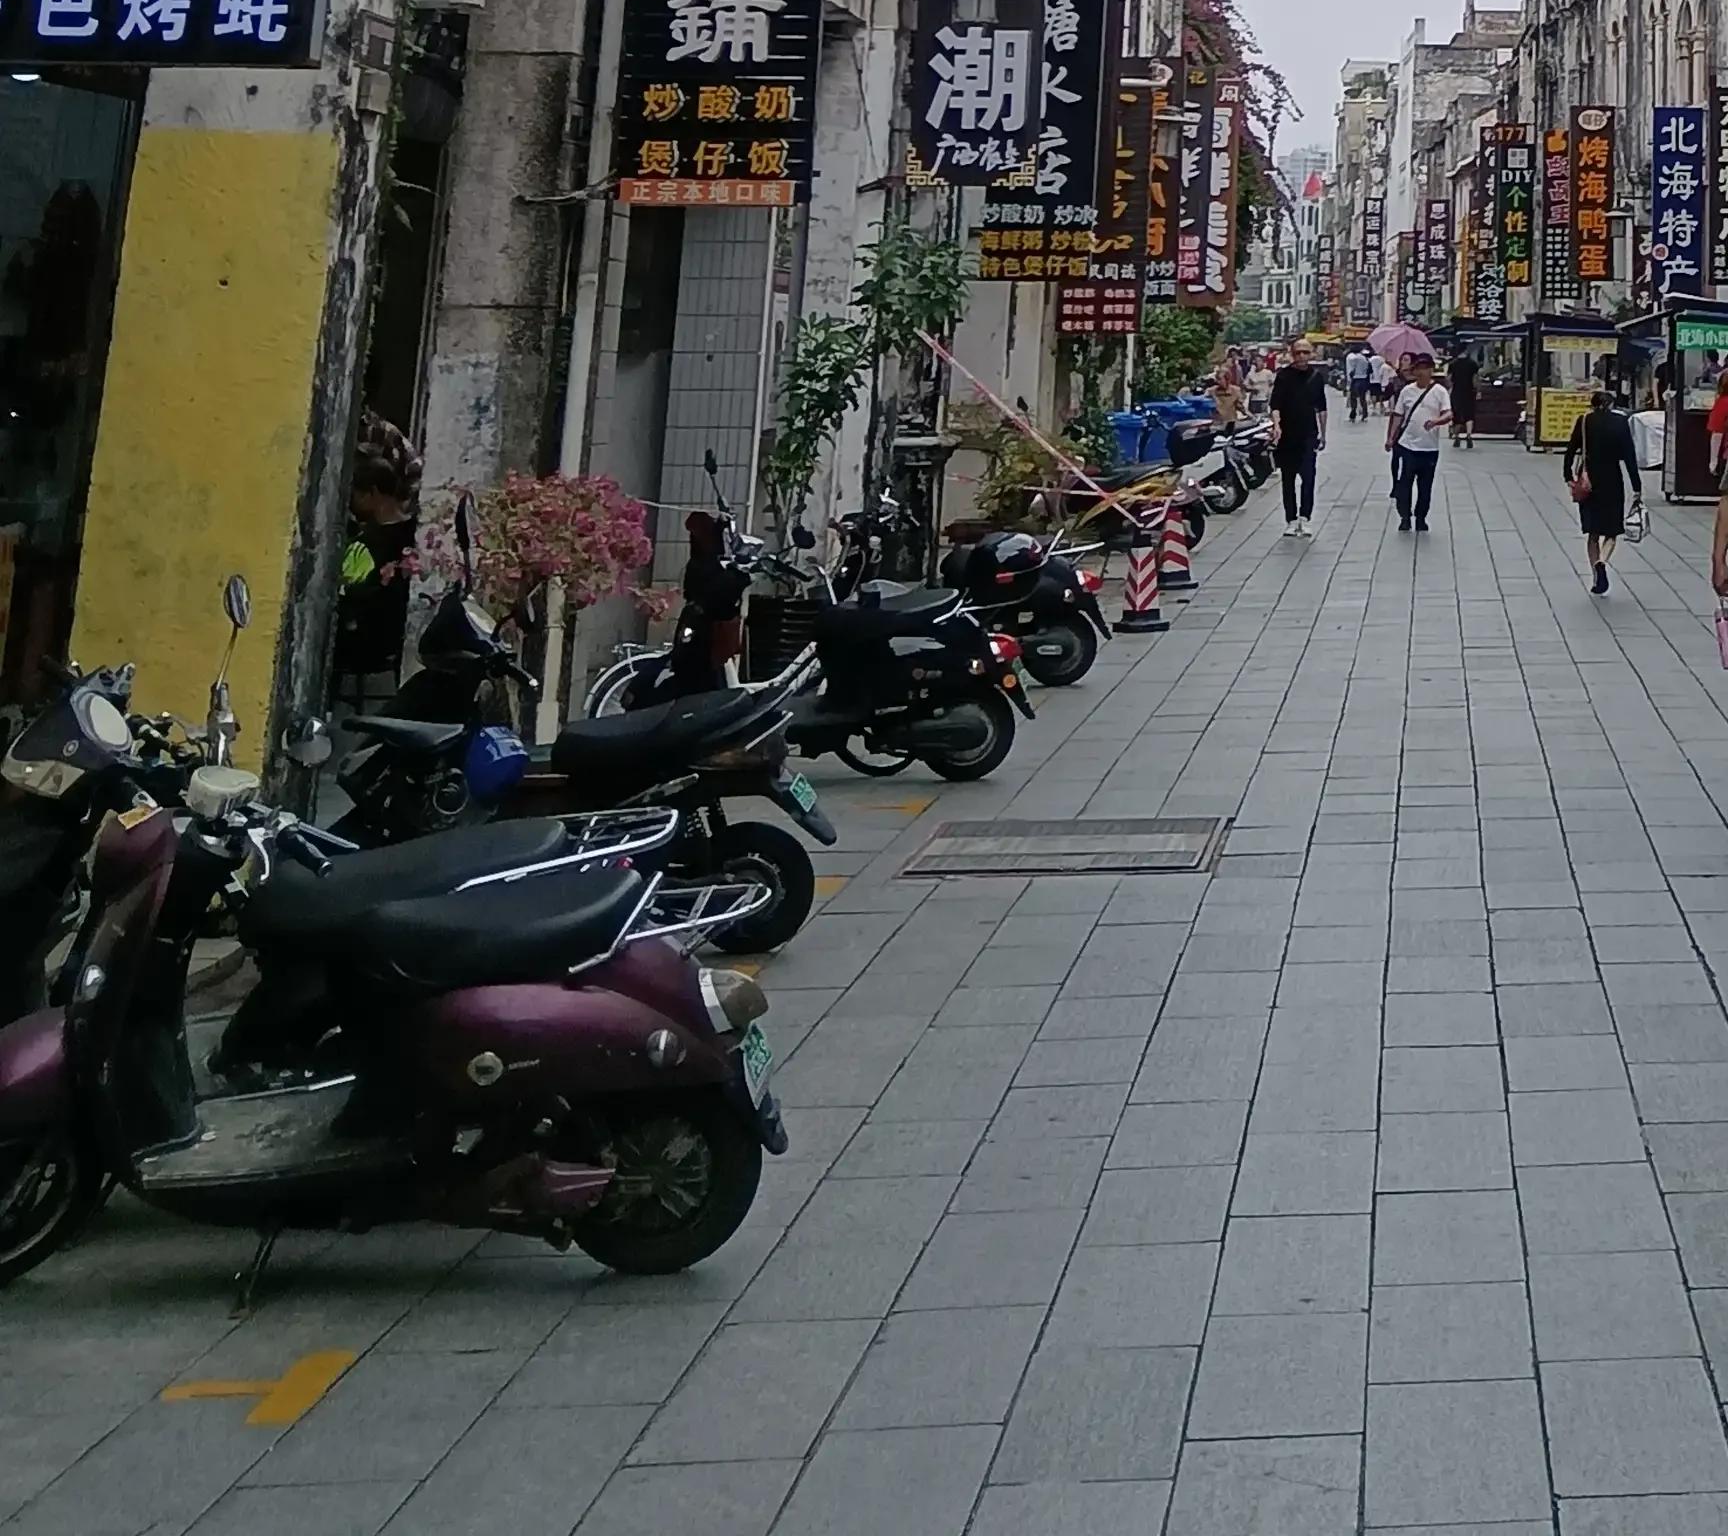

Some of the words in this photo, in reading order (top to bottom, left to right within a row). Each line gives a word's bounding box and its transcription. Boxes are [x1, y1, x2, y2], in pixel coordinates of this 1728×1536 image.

[642, 83, 795, 123] 炒酸奶
[637, 139, 789, 178] 煲仔饭
[1501, 169, 1534, 183] DIY
[1577, 135, 1609, 277] 烤海鸭蛋
[1658, 116, 1700, 294] 北海特产
